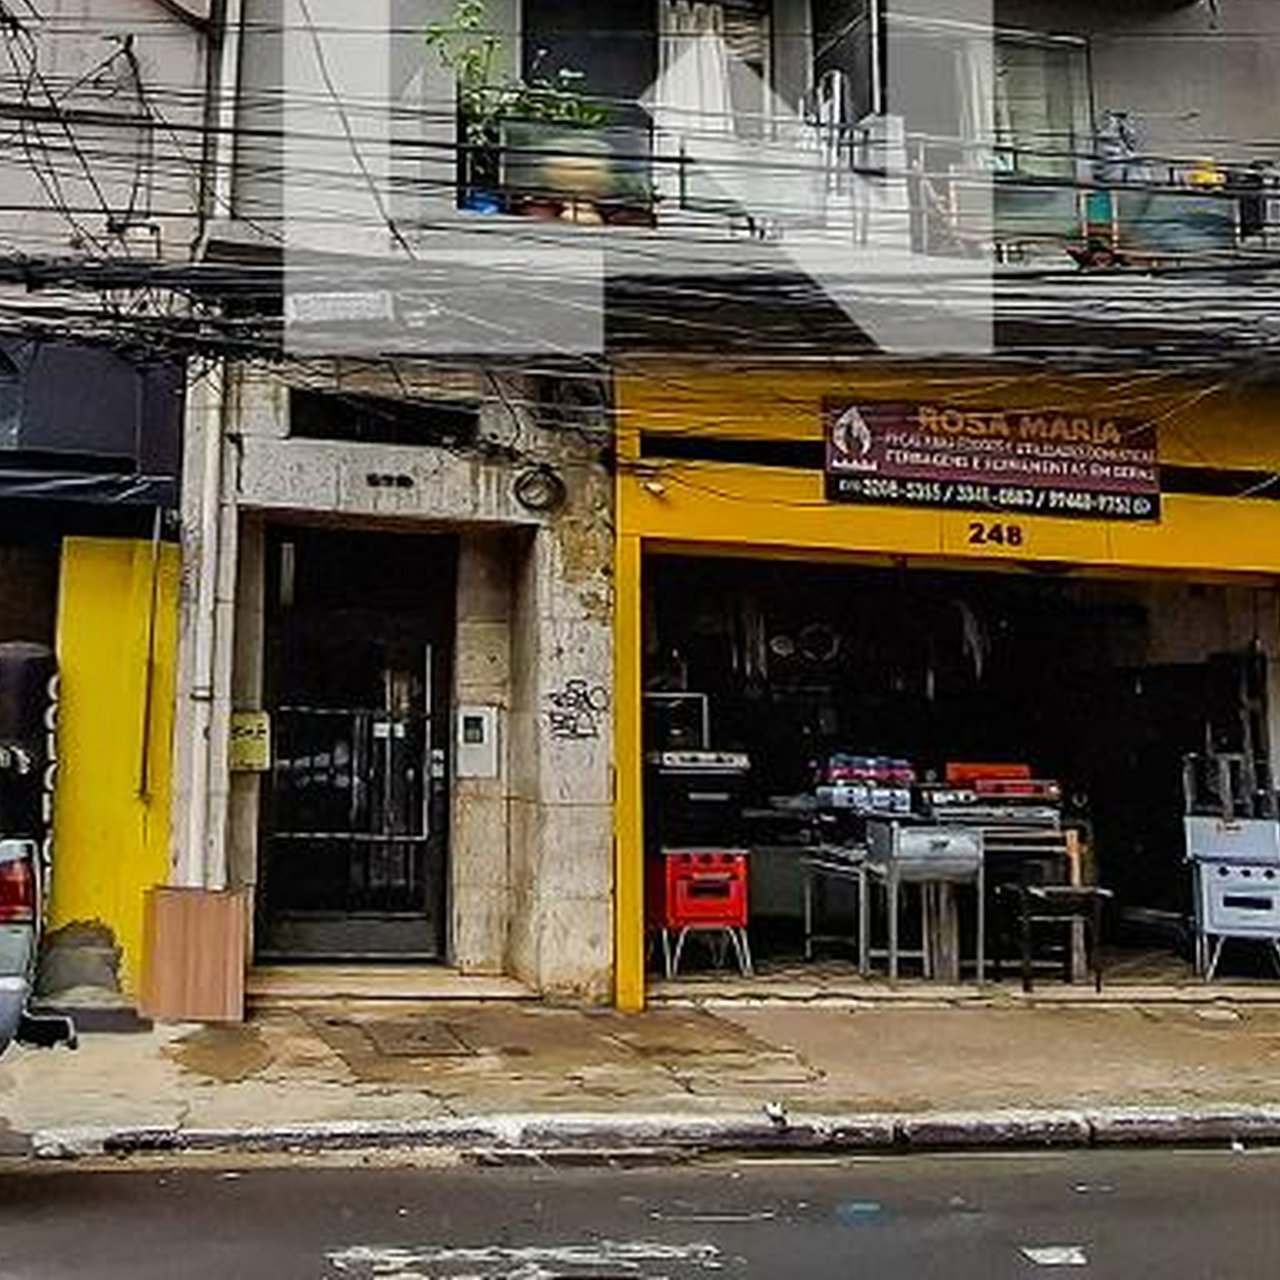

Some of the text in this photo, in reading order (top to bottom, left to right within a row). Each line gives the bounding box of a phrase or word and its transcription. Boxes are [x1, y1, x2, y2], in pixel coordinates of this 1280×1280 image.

[919, 406, 1121, 444] ROSA MARIA
[968, 522, 1023, 547] 248
